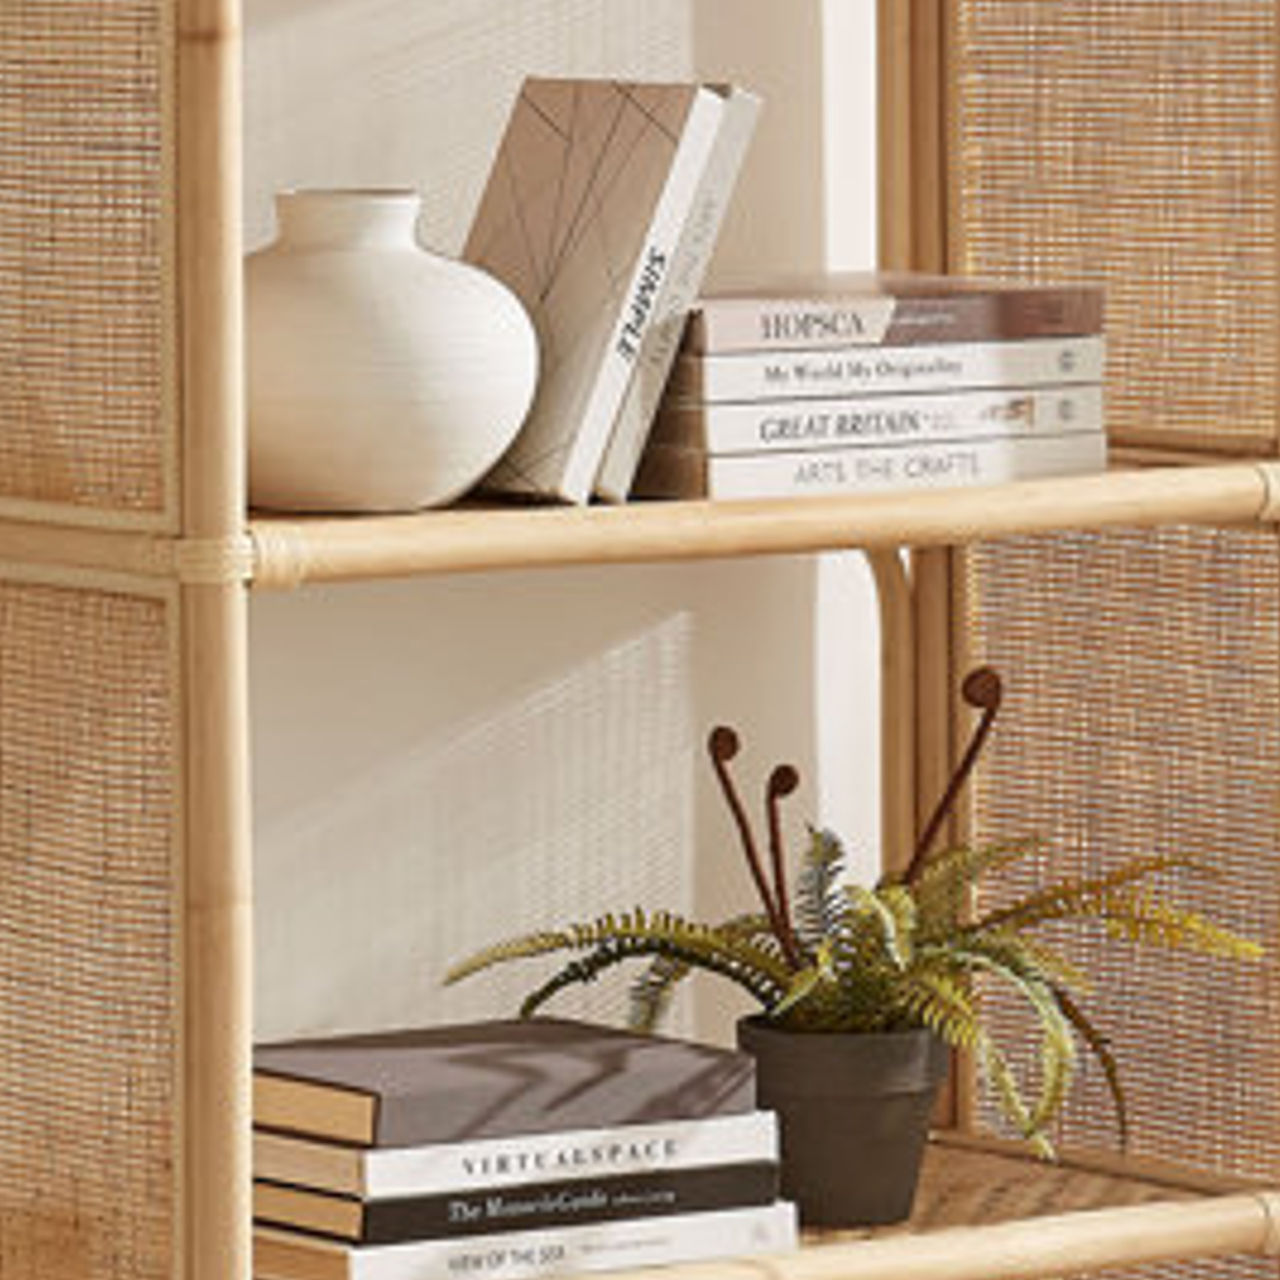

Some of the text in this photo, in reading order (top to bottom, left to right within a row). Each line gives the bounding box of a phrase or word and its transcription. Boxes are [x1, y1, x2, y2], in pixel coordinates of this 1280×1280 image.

[764, 365, 790, 382] My
[794, 361, 842, 382] World
[847, 360, 872, 380] My
[758, 416, 829, 443] GREAT
[834, 410, 922, 437] BRITAIN
[793, 451, 980, 483] ARTS THE CRAFTS
[448, 1200, 483, 1223] The
[487, 1247, 505, 1269] OF
[509, 1246, 536, 1265] THE
